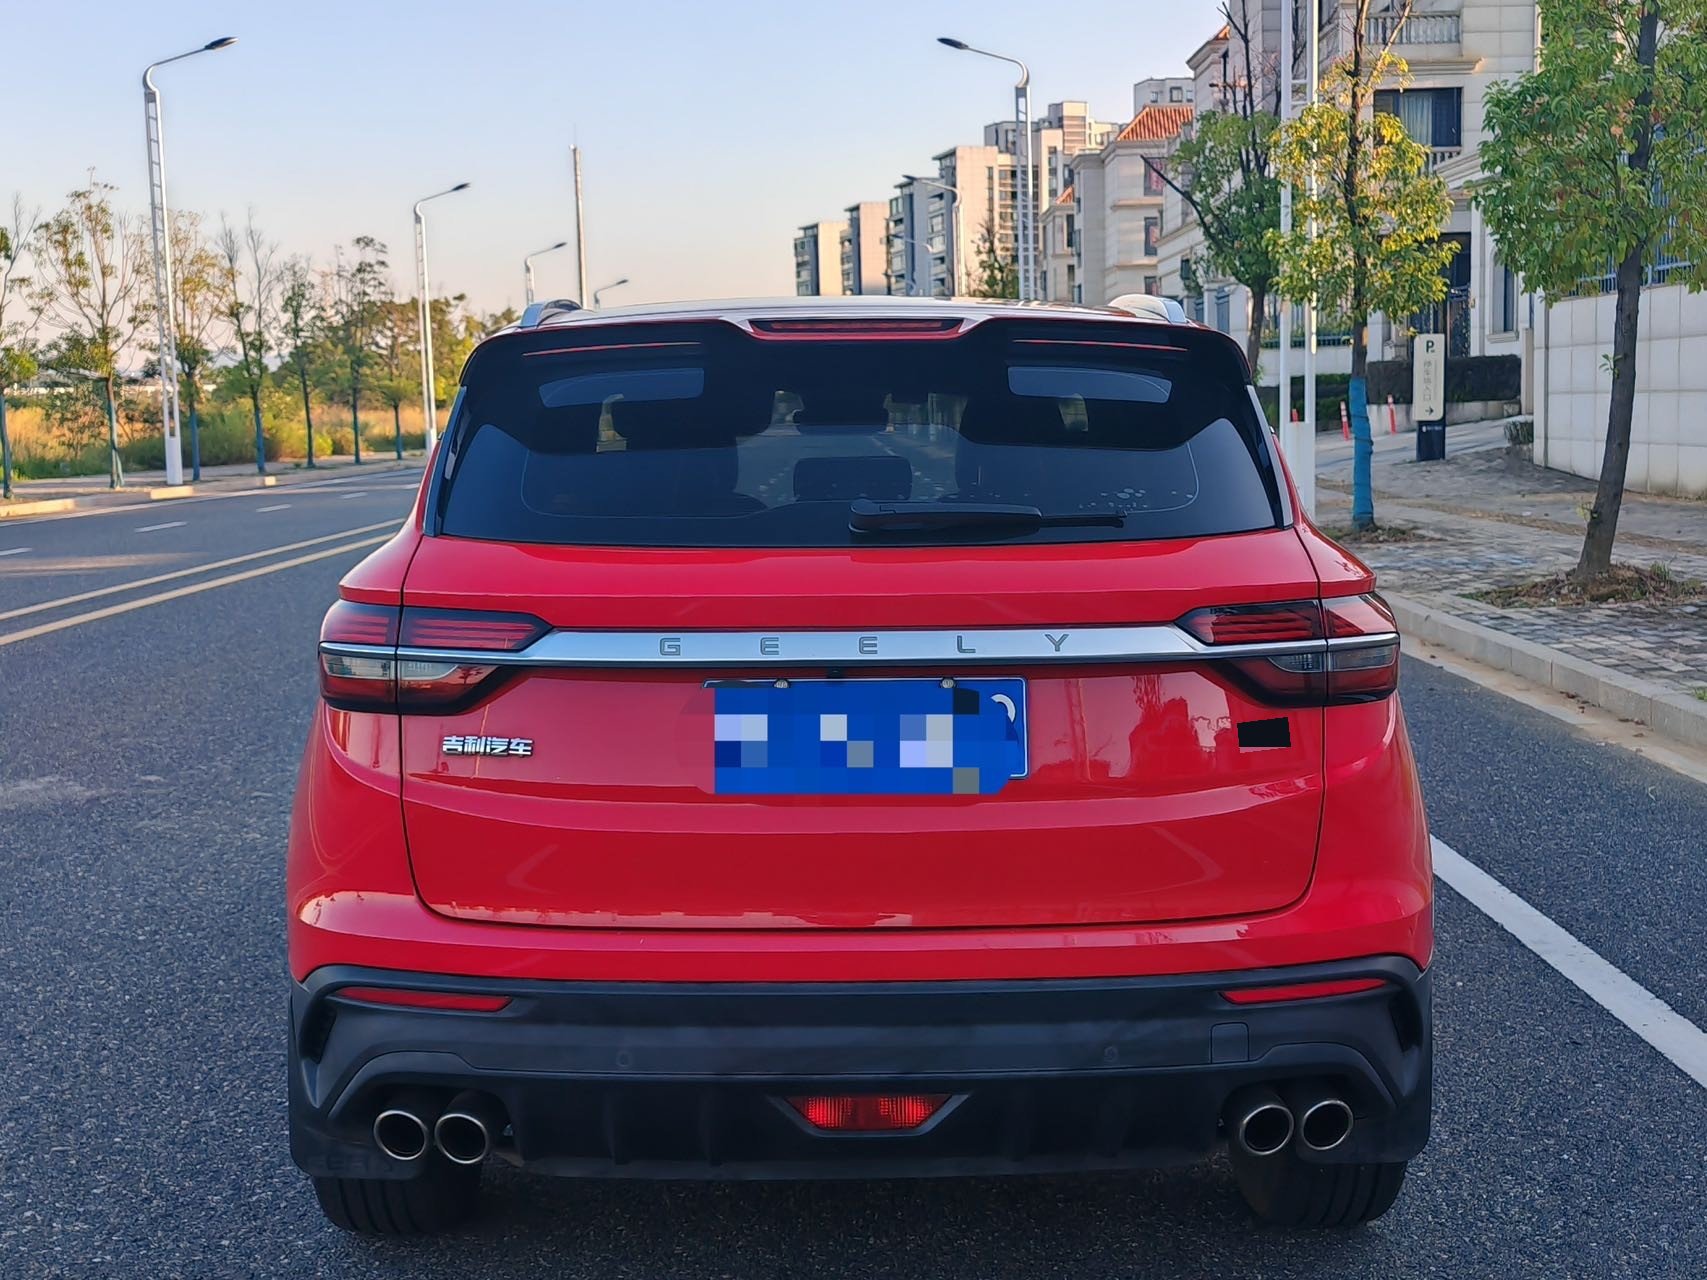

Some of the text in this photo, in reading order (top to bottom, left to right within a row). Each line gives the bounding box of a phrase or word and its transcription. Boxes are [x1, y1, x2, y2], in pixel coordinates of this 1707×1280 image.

[1426, 340, 1435, 353] P
[659, 634, 1069, 656] GEELY
[442, 735, 533, 756] 吉利汽车
